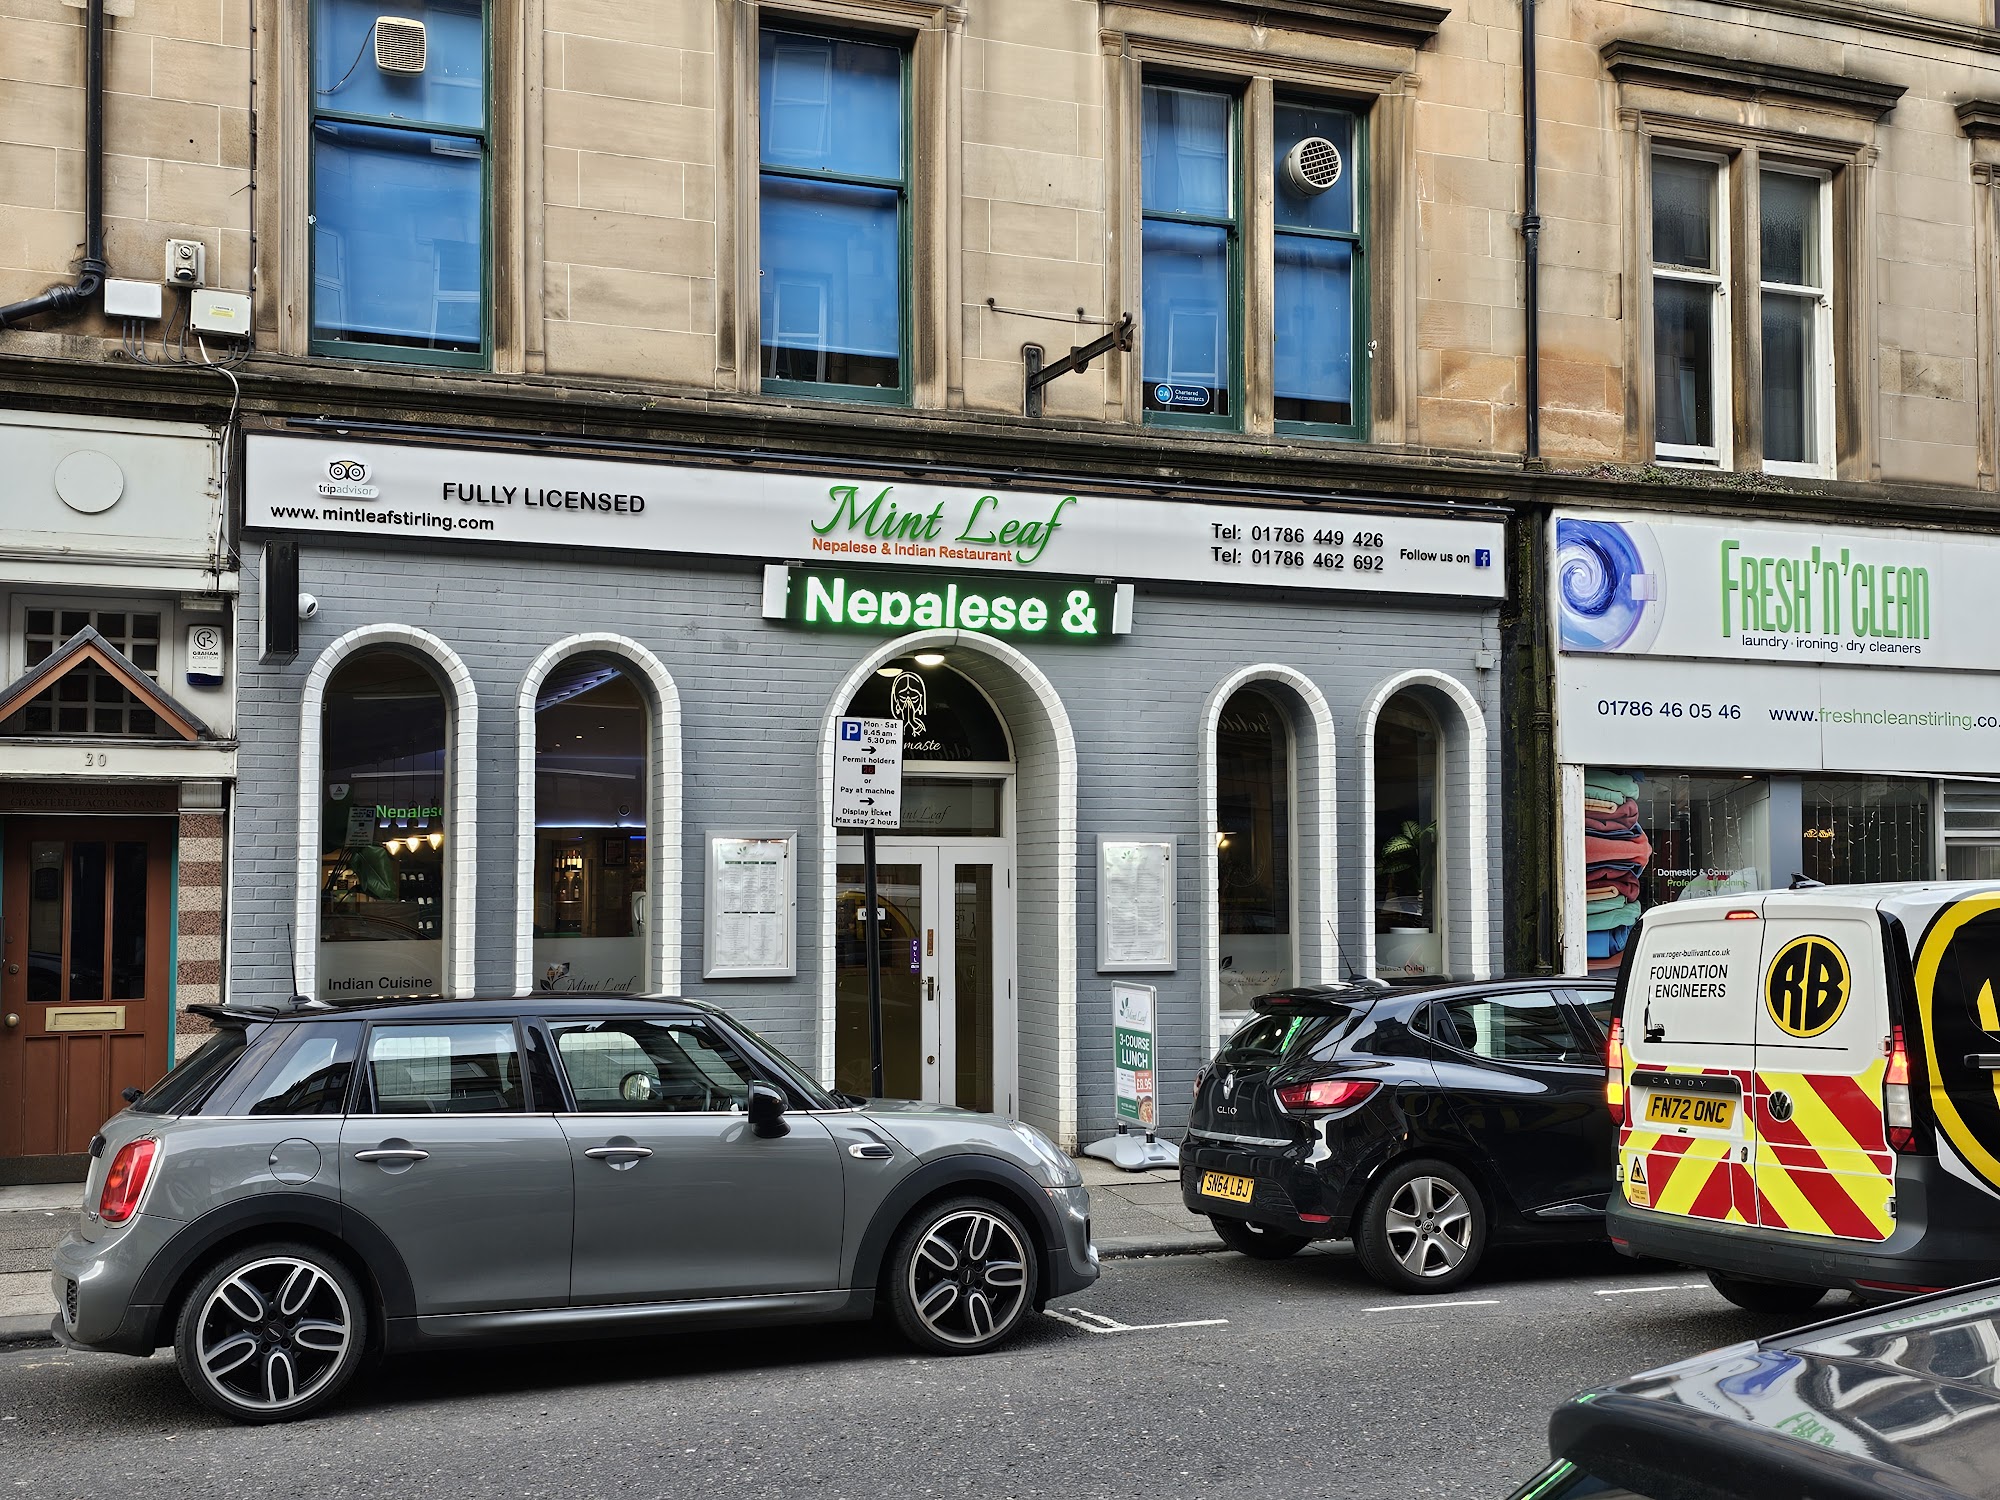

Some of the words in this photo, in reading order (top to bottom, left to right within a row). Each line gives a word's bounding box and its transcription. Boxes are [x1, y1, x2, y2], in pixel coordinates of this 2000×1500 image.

[318, 484, 374, 495] tripadvisor
[443, 482, 518, 505] FULLY
[524, 487, 646, 514] LICENSED
[811, 485, 946, 541] Mint
[954, 495, 1077, 564] Leaf
[1211, 523, 1242, 541] Tel:
[1251, 525, 1305, 544] 01786
[1313, 529, 1345, 547] 449
[1352, 532, 1384, 548] 426
[812, 537, 877, 555] Nepalese
[881, 542, 892, 555] &
[894, 543, 936, 558] Indian
[939, 546, 1013, 562] Restaurant
[1400, 548, 1437, 562] Follow
[1439, 552, 1453, 563] us
[1456, 553, 1470, 564] on
[1211, 546, 1242, 564] Tel:
[1251, 549, 1305, 567] 01786
[1313, 552, 1345, 569] 462
[1353, 555, 1384, 571] 692
[1061, 590, 1097, 634] &
[1742, 635, 1789, 650] laundry
[1796, 637, 1838, 652] ironing
[1846, 639, 1866, 653] dry
[1869, 640, 1921, 654] cleaners
[1597, 699, 1653, 717] 01786
[1659, 701, 1683, 718] 46
[1688, 703, 1713, 719] 05
[1718, 704, 1741, 720] 46
[884, 721, 898, 729] Sat
[904, 740, 942, 751] maste
[84, 752, 107, 768] 20
[868, 757, 895, 765] holders
[840, 786, 853, 794] Pay
[842, 808, 869, 817] Display
[871, 808, 892, 817] ticket
[903, 807, 918, 819] int
[835, 816, 851, 824] Max
[852, 818, 868, 826] stay
[877, 818, 898, 826] hours
[1657, 868, 1697, 877] Domestic
[1699, 868, 1704, 876] &
[1650, 964, 1729, 980] FOUNDATION
[328, 976, 374, 991] Indian
[378, 976, 433, 989] Cuisine
[603, 976, 637, 992] Leaf
[1655, 983, 1727, 998] ENGINEERS
[1119, 1033, 1150, 1051] 3-COURSE
[1121, 1048, 1149, 1069] LUNCH
[1652, 1077, 1707, 1088] CADDY
[1216, 1105, 1238, 1115] CLIO
[1651, 1096, 1691, 1120] FN72
[1693, 1100, 1728, 1124] ONC
[1206, 1174, 1230, 1193] SN64
[1230, 1177, 1250, 1197] LBJ
